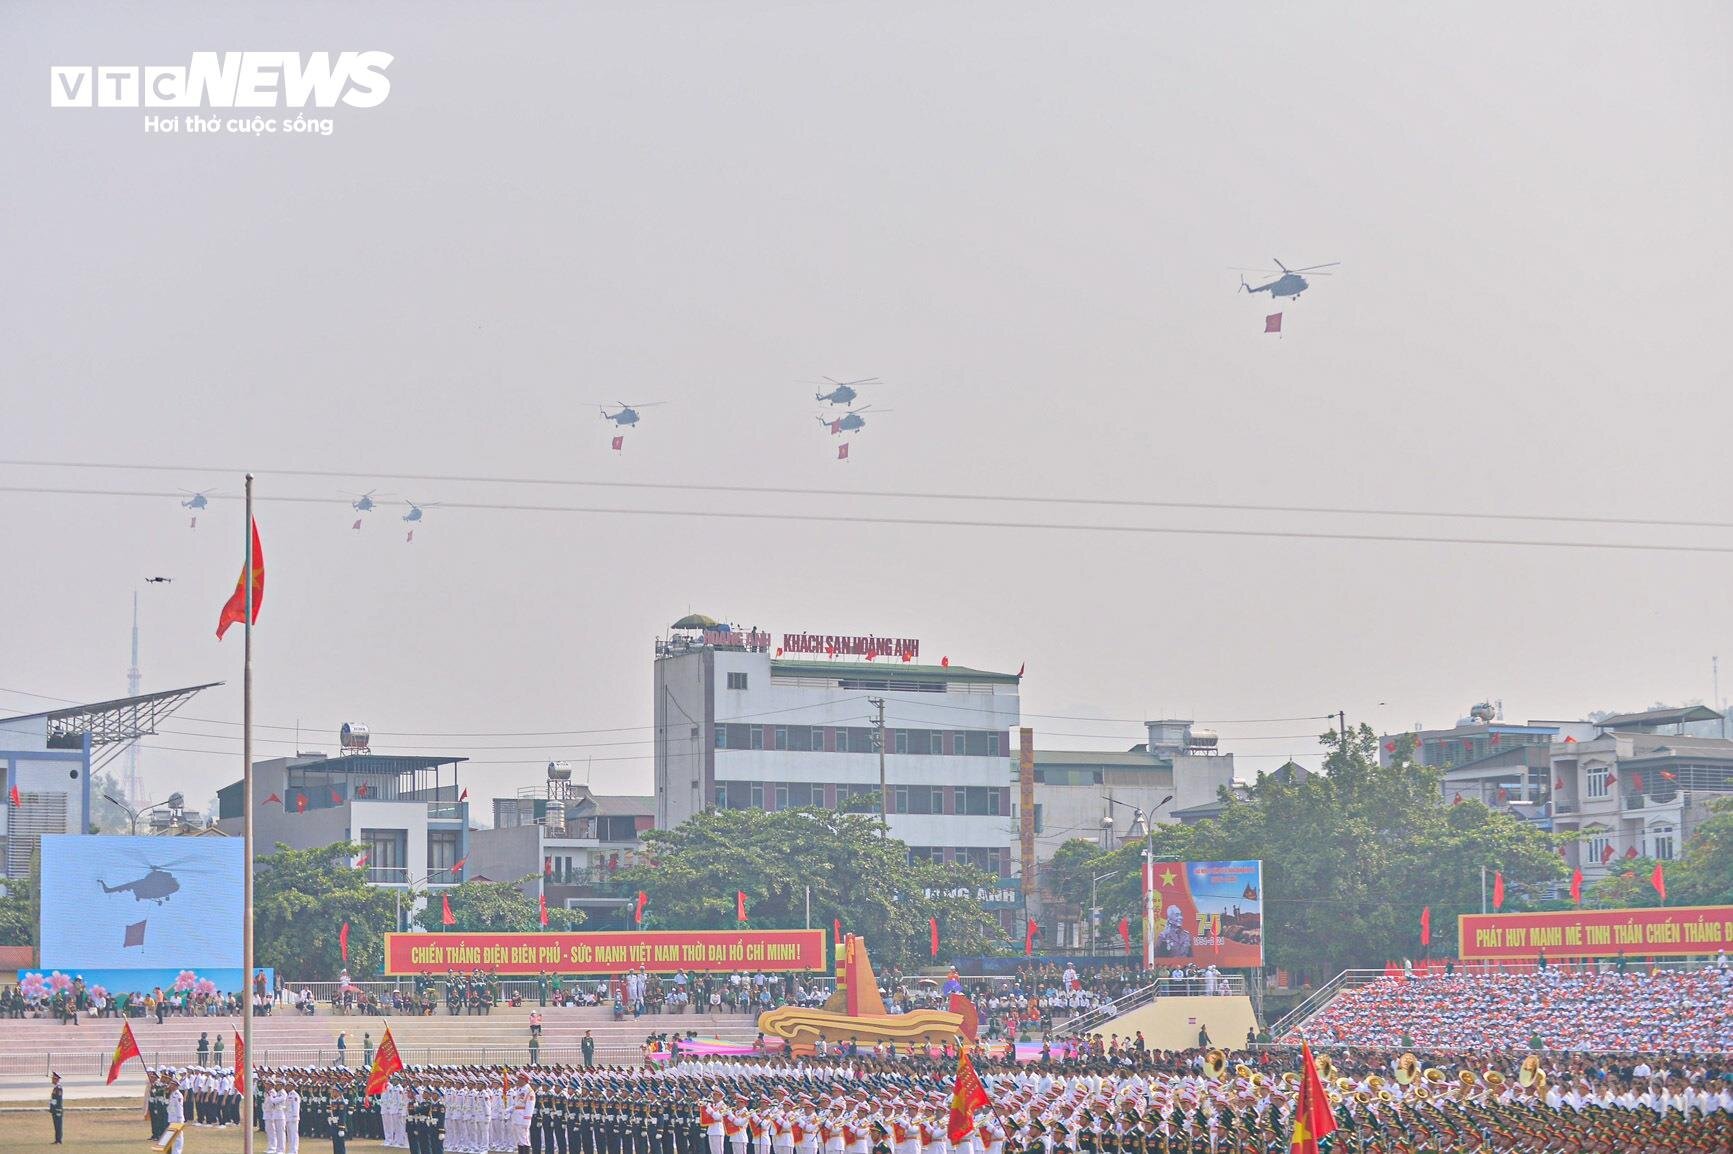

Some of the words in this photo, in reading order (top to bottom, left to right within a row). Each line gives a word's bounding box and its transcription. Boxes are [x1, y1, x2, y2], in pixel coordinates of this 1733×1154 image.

[783, 631, 824, 653] KHÁCH
[825, 636, 850, 657] SẠN
[854, 634, 893, 657] HOÀNG
[894, 638, 919, 657] ANH
[1476, 924, 1502, 947] PHÁT
[1505, 927, 1526, 947] HUY
[1565, 922, 1582, 946] MẼ
[1585, 925, 1611, 945] TINH
[1613, 917, 1643, 944] THẦN
[1646, 916, 1680, 944] CHIẾN
[1683, 915, 1721, 943] THẮNG
[411, 941, 443, 964] CHIẾN
[446, 941, 480, 964] THẮNG
[483, 943, 509, 967] ĐIỆN
[511, 943, 536, 964] BIÊN
[539, 941, 560, 963] PHỦ
[570, 943, 592, 963] SỨC
[595, 945, 627, 966] MẠNH
[629, 941, 651, 966] VIỆT
[654, 944, 679, 962] NAM
[682, 940, 705, 961] THỜI
[708, 944, 726, 964] ĐẠI
[729, 938, 743, 961] HỒ
[747, 940, 764, 961] CHÍ
[767, 943, 800, 960] MINH!
